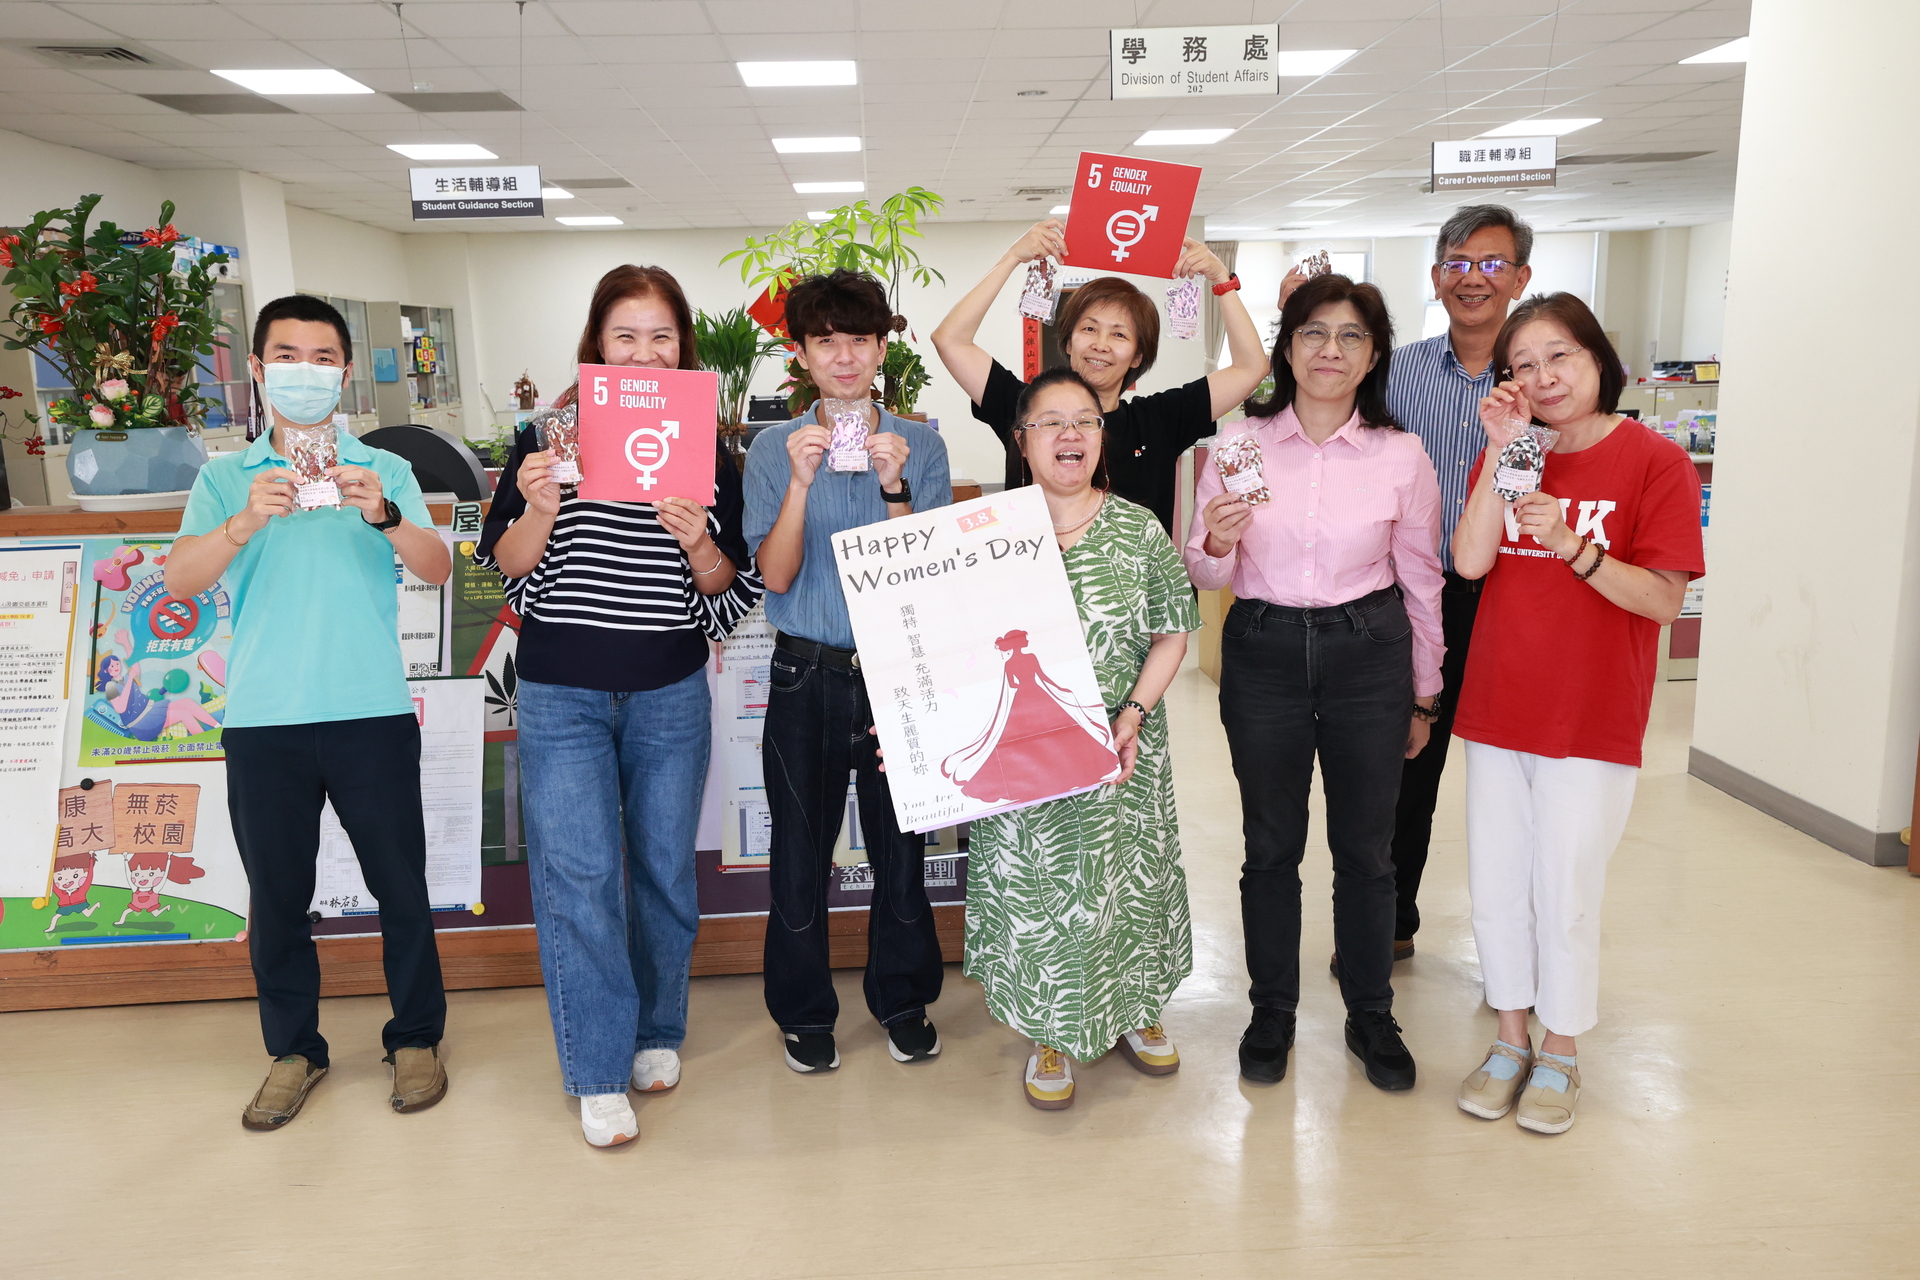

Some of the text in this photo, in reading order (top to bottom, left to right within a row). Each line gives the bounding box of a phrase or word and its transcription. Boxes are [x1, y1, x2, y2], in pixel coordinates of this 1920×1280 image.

[1121, 34, 1269, 65] 學務處
[1121, 69, 1269, 85] Division of Student Affairs
[1187, 84, 1203, 93] 202
[1458, 147, 1532, 163] 職涯輔導組
[1087, 163, 1103, 188] 5
[1112, 166, 1148, 181] GENDER
[1438, 172, 1551, 185] Career Development Section
[434, 176, 518, 193] 生活輔導組
[1109, 180, 1152, 196] EQUALITY
[421, 200, 534, 211] Student Guidance Section
[593, 376, 608, 406] 5
[620, 379, 659, 393] GENDER
[620, 394, 667, 409] EQUALITY
[453, 504, 481, 532] 屋
[961, 511, 991, 531] 3.8
[840, 525, 935, 560] Happy
[1517, 548, 1556, 559] UNIVERSITY
[847, 535, 1044, 594] Women's Day
[146, 638, 196, 653] 拒菸有理
[899, 603, 939, 715] 獨特 智慧 充滿活力
[411, 686, 428, 694] 公告
[91, 744, 170, 757] 未滿20歲禁止吸菸
[63, 795, 87, 819] 康
[126, 793, 179, 816] 無菸
[903, 794, 953, 811] You Are
[905, 803, 964, 826] Beautiful
[133, 822, 185, 845] 校園
